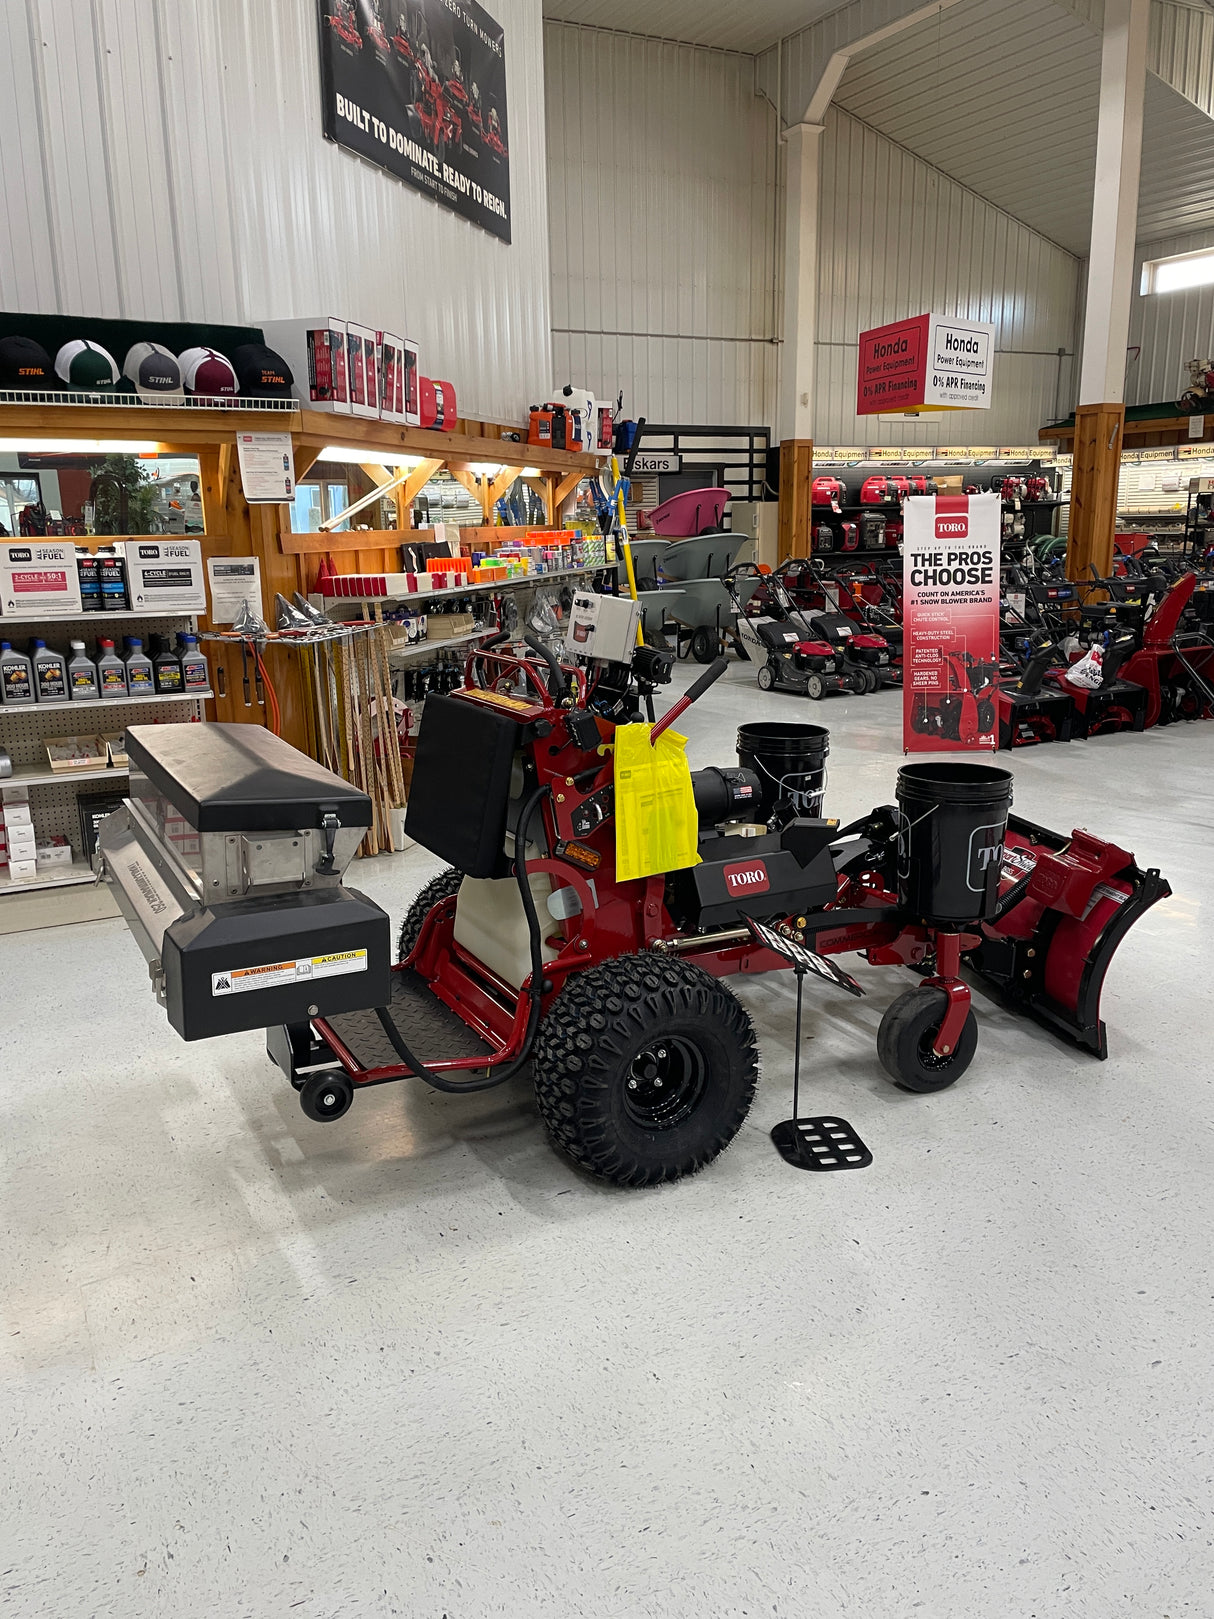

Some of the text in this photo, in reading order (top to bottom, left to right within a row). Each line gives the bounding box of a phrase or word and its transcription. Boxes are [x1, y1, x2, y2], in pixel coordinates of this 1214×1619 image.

[463, 11, 478, 35] TURN
[336, 92, 370, 133] BUILT
[372, 115, 387, 144] TO
[389, 127, 442, 179] DOMINATE.
[443, 163, 471, 196] READY
[471, 181, 482, 204] TO
[483, 189, 507, 219] REIGN.
[873, 336, 908, 360] Honda
[946, 332, 979, 354] Honda
[866, 355, 915, 375] Power Equipment
[936, 353, 985, 369] Power Equipment
[148, 376, 174, 384] STIHL
[863, 377, 918, 397] 0% APR Financing
[933, 374, 986, 395] 0% APR Financing
[834, 450, 868, 459] Equipment
[882, 449, 935, 458] Honda Equipment
[949, 449, 998, 458] Honda Equipment
[1029, 449, 1057, 458] Equipment
[1140, 450, 1176, 459] Equipment
[623, 457, 670, 470] Fskars
[938, 522, 966, 532] TORO
[910, 551, 993, 567] THE PROS
[910, 567, 993, 587] CHOOSE
[728, 869, 765, 887] TORO
[327, 952, 357, 962] CAUTION
[250, 964, 283, 974] WARNING
